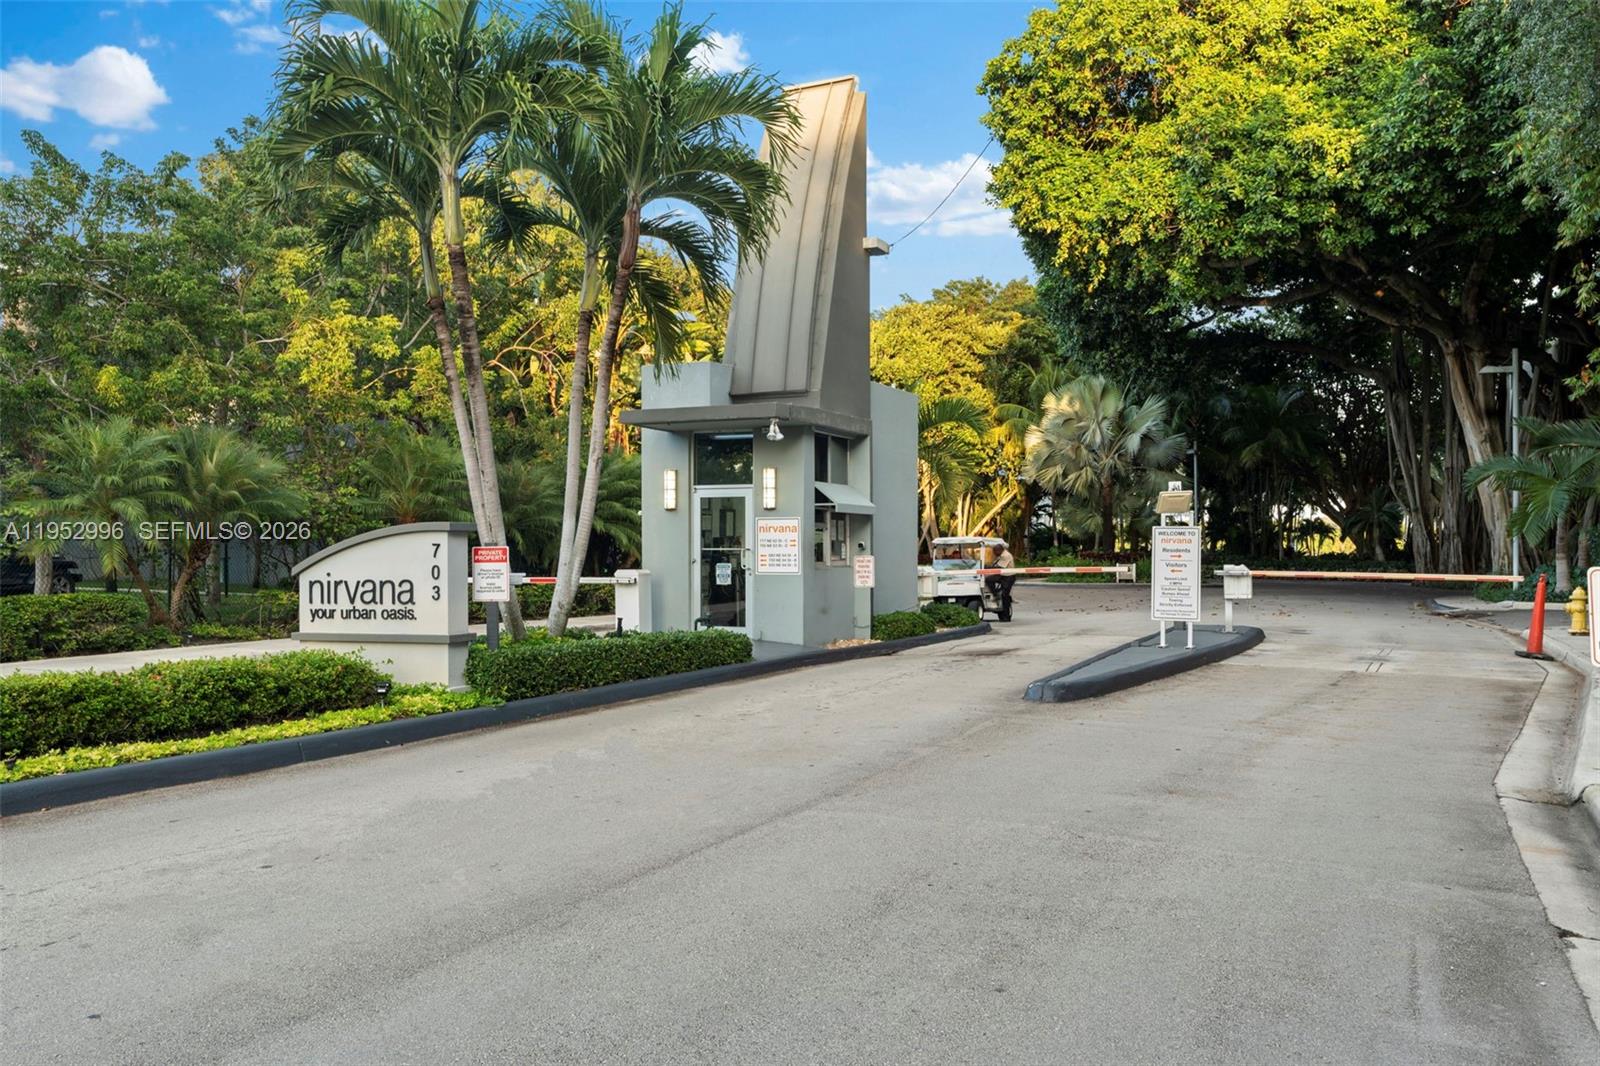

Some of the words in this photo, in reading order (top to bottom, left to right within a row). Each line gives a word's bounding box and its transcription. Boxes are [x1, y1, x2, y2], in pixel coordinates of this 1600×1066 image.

[758, 524, 798, 533] nirvana
[431, 543, 441, 601] 703
[308, 572, 416, 605] nirvana
[310, 608, 337, 623] your
[340, 606, 377, 620] urban
[381, 607, 417, 621] oasis.
